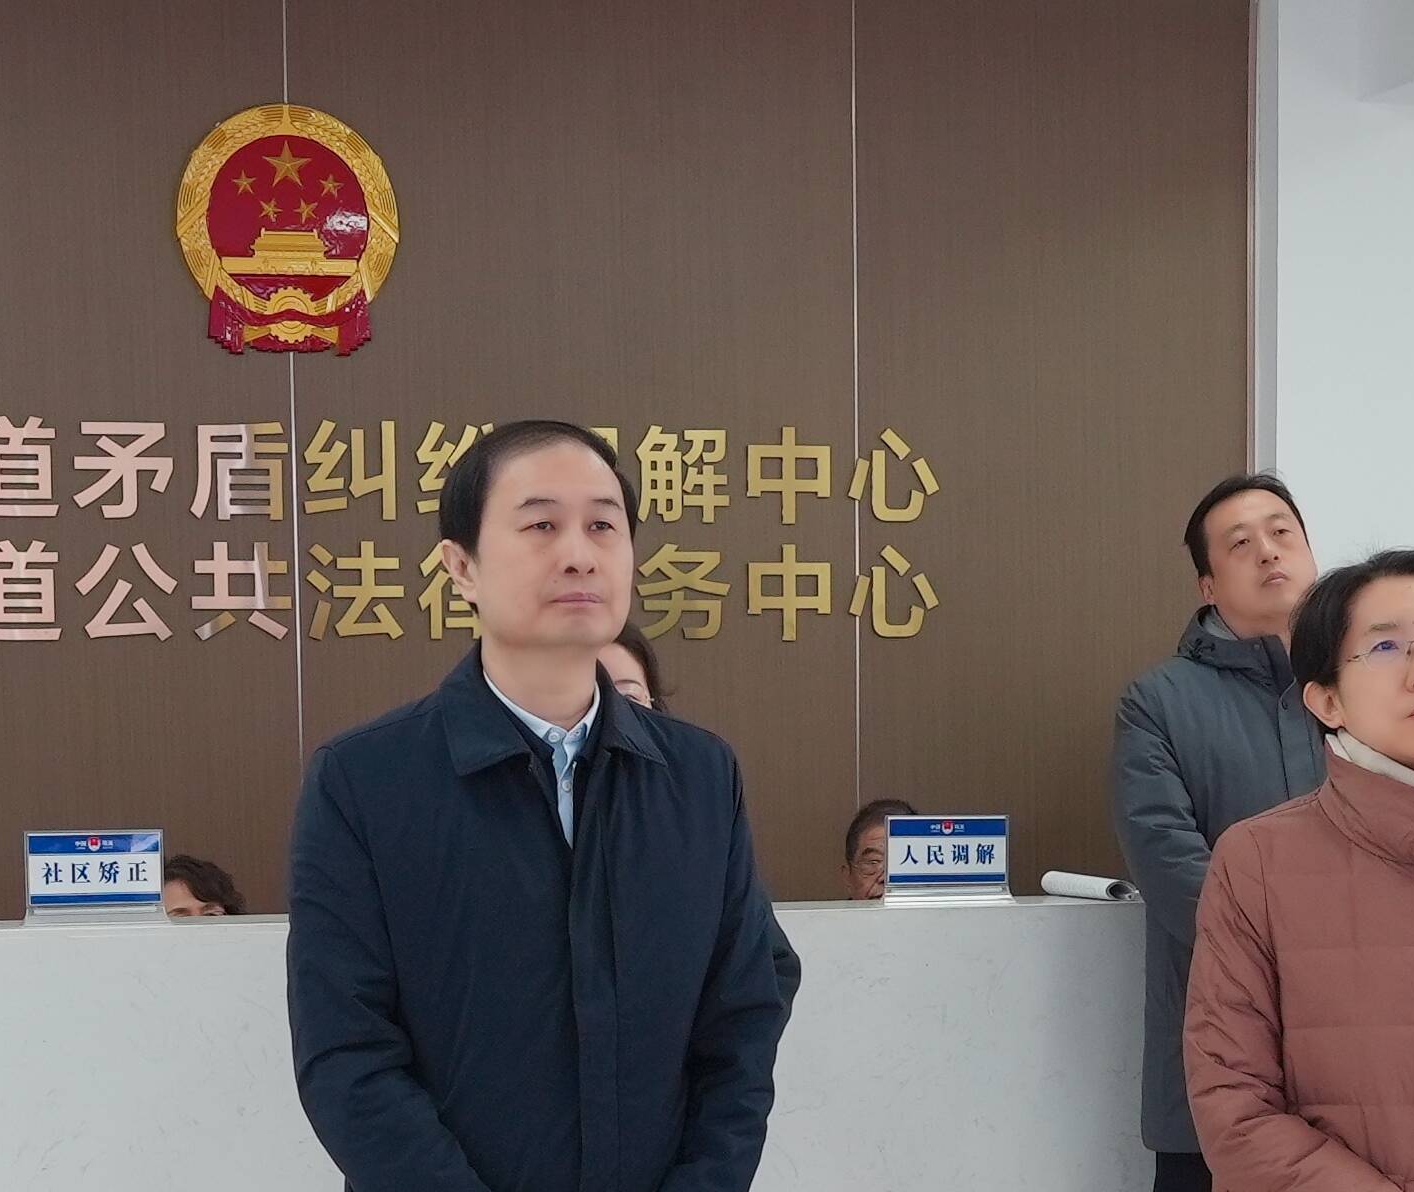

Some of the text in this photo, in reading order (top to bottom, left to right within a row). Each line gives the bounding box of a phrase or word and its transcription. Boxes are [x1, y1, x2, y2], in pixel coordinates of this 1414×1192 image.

[900, 843, 996, 865] 人民调解
[42, 861, 148, 885] 社区矫正
